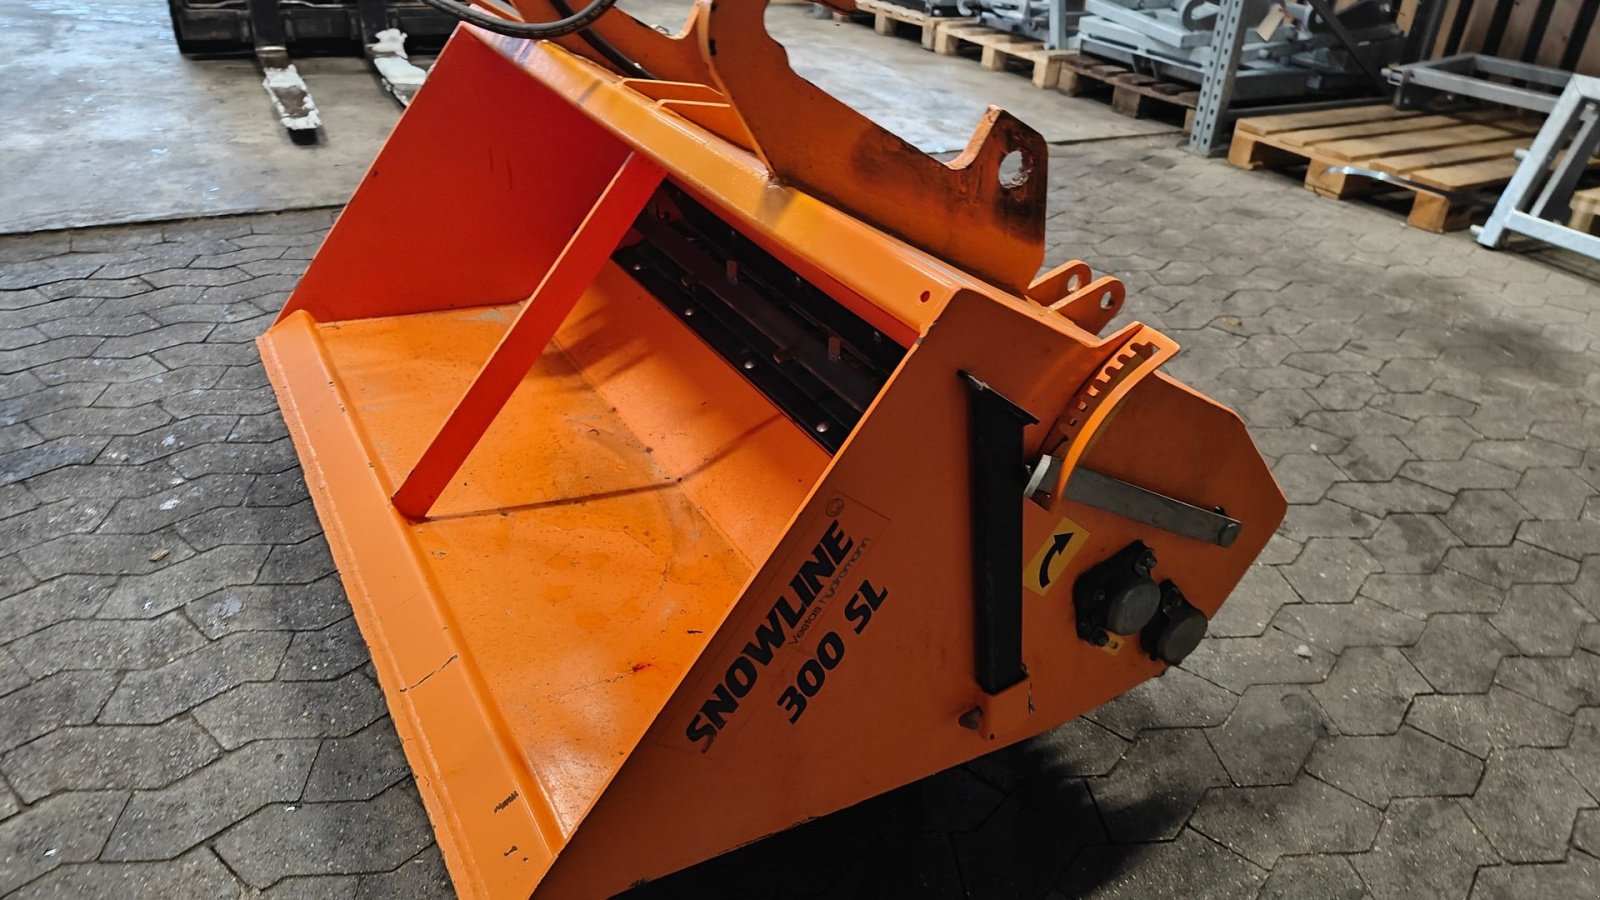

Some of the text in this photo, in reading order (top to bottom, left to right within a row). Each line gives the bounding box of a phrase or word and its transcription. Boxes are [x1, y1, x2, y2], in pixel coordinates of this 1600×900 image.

[685, 519, 853, 754] SNOWLINE
[777, 579, 888, 724] 300 SL
[789, 537, 871, 645] Vestas hydromann
